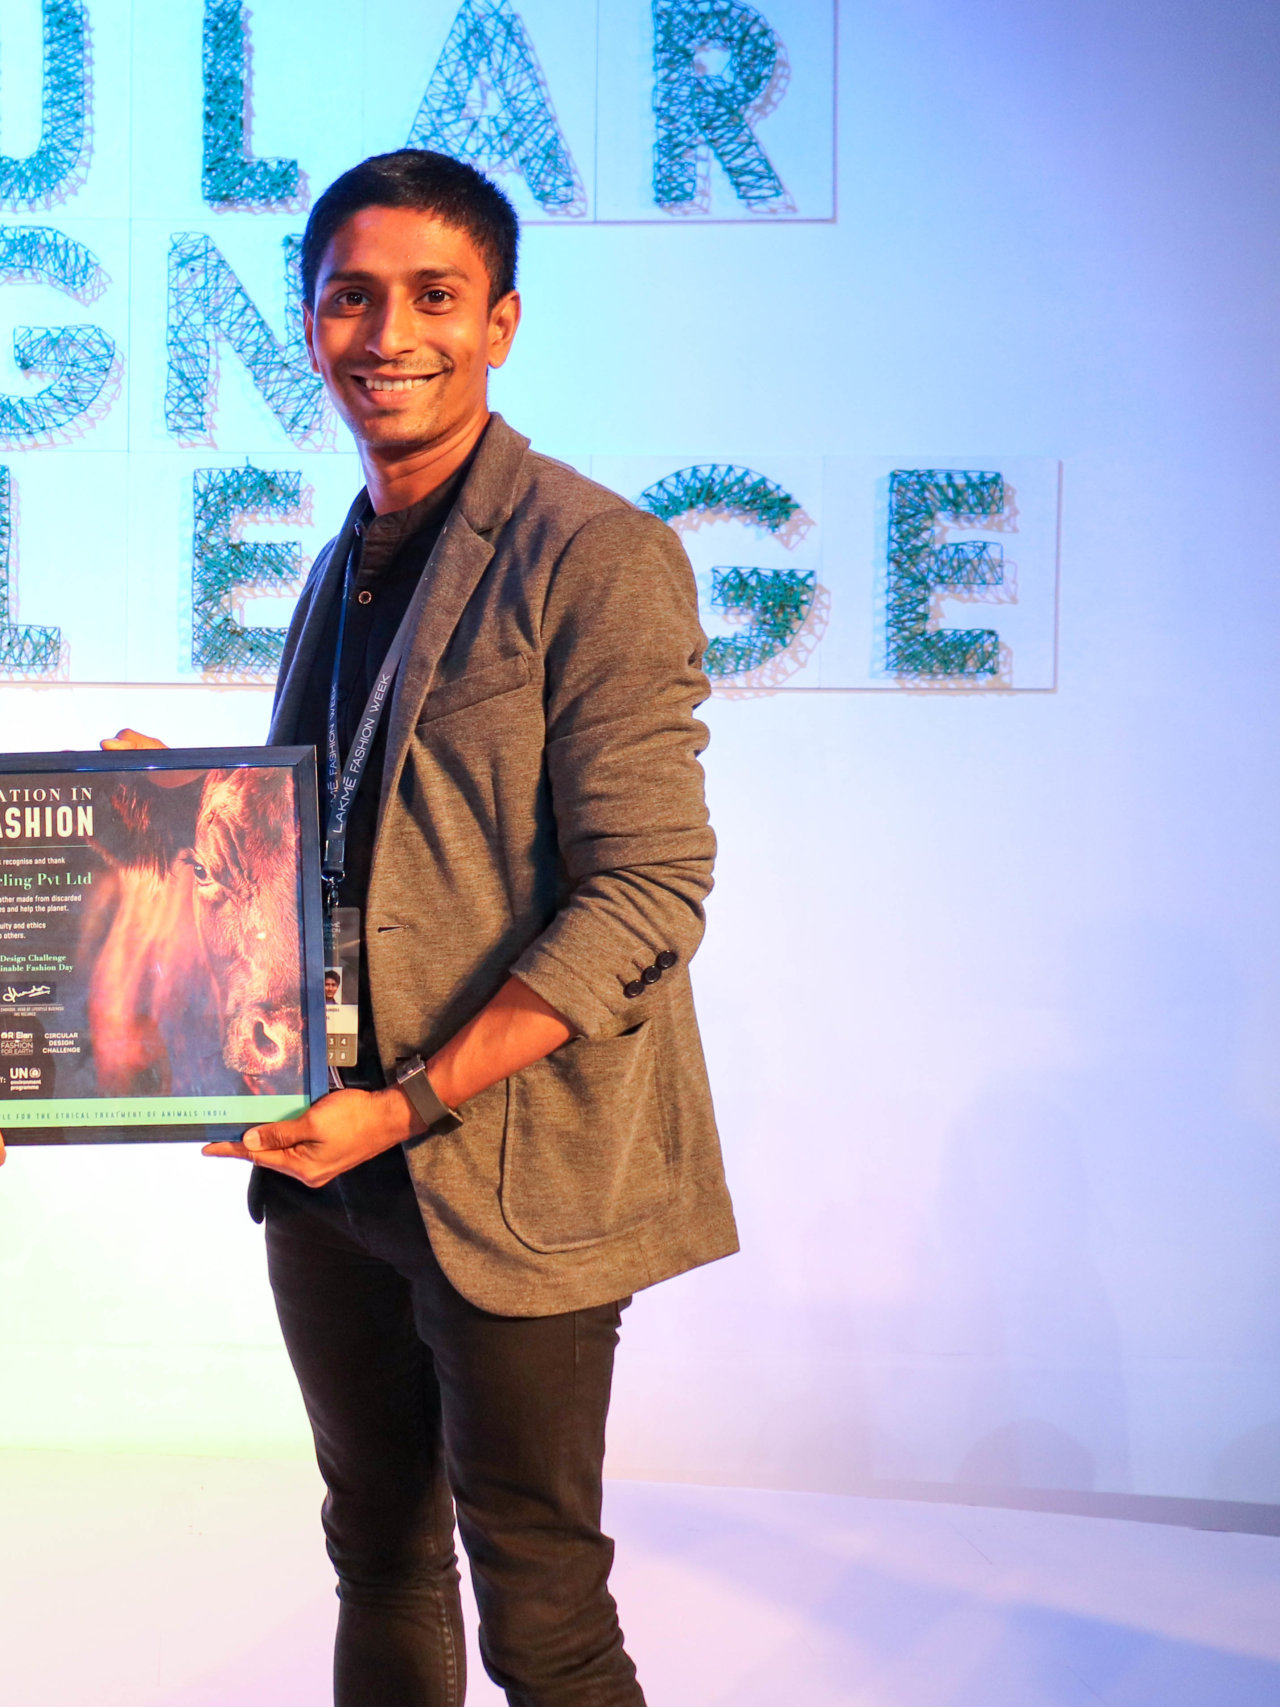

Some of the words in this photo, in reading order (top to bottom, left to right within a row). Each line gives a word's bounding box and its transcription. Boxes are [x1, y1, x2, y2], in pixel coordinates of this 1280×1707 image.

[349, 718, 376, 773] FASHION
[369, 674, 391, 712] WEEK
[71, 787, 93, 801] IN
[3, 858, 33, 866] recognise
[34, 857, 46, 865] and
[37, 872, 60, 886] Pvt
[66, 871, 92, 885] Ltd
[16, 895, 33, 903] made
[51, 894, 82, 902] discarded
[20, 905, 33, 914] help
[47, 904, 69, 912] planet.
[0, 954, 26, 963] Design
[28, 953, 67, 963] Challenge
[58, 963, 73, 973] Day
[95, 1111, 142, 1119] TREATMENT
